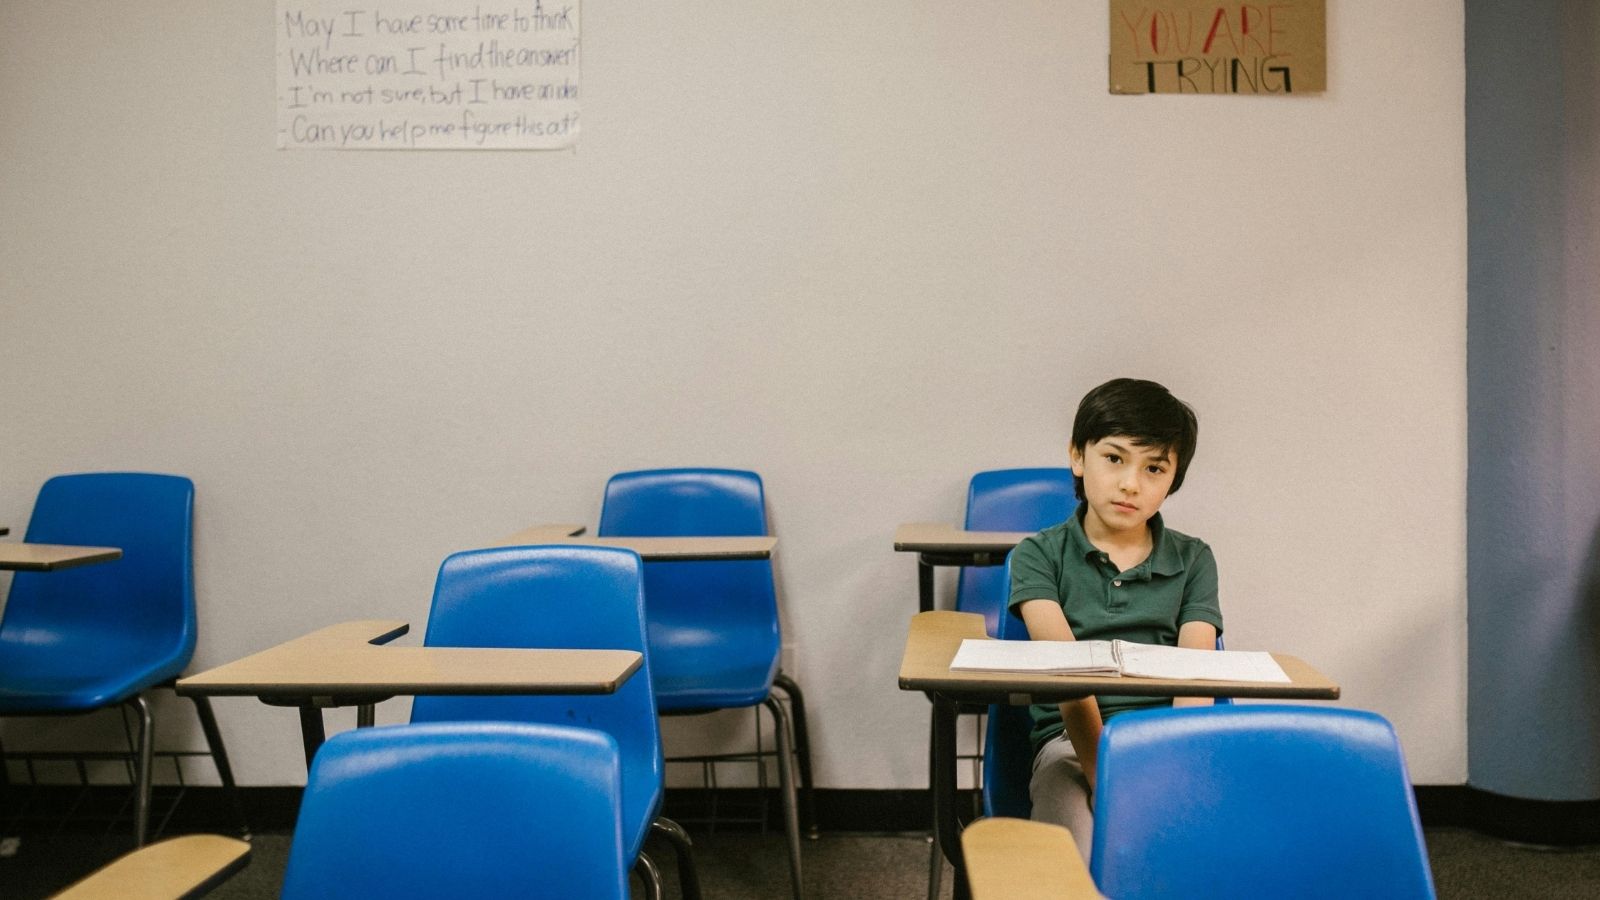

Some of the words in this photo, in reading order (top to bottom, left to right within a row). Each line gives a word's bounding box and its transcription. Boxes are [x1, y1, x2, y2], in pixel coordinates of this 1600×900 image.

[285, 10, 334, 49] May
[342, 10, 366, 37] I
[375, 10, 422, 33] have
[427, 13, 468, 34] some
[472, 5, 508, 32] time
[513, 8, 529, 33] to
[1121, 7, 1192, 57] YOU
[1202, 6, 1296, 57] ARE
[290, 48, 358, 77] Where
[365, 54, 398, 75] can
[401, 47, 427, 75] I
[433, 42, 484, 81] find
[486, 39, 515, 69] the
[1133, 56, 1292, 93] TRYING
[288, 85, 333, 109] I'm
[341, 85, 375, 105] not
[381, 88, 426, 104] sure,
[429, 83, 463, 105] but
[468, 79, 488, 104] I
[492, 79, 534, 101] have
[537, 83, 554, 100] an
[341, 123, 374, 146] you
[379, 119, 427, 147] help
[430, 124, 455, 135] me
[459, 109, 512, 145] figure
[514, 115, 544, 137] this
